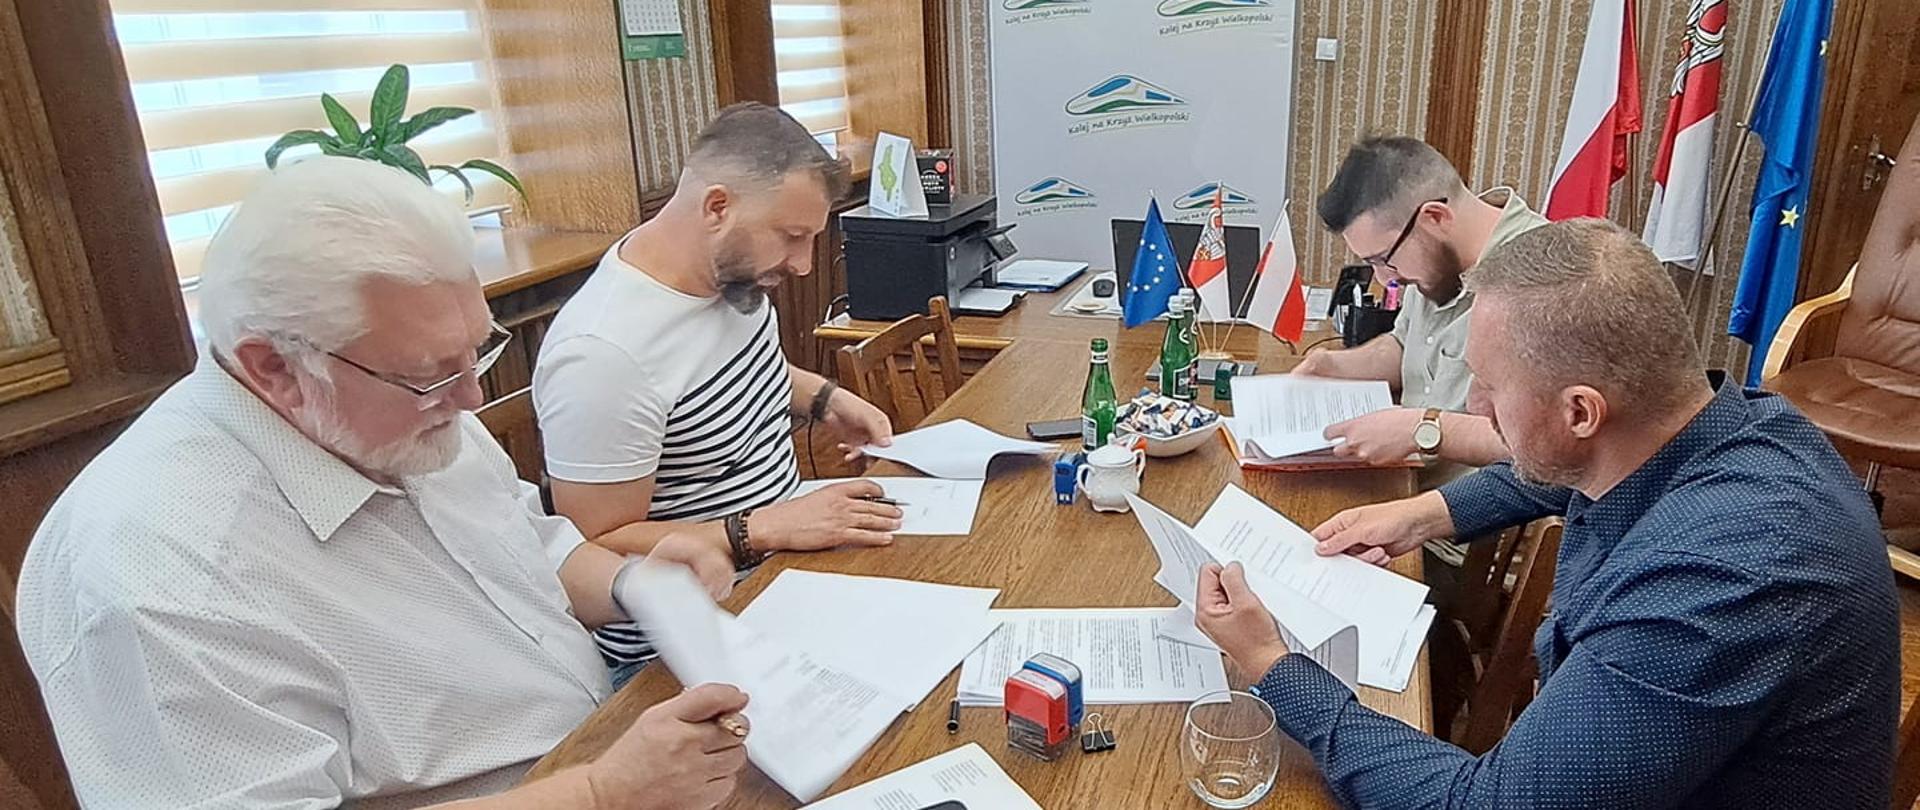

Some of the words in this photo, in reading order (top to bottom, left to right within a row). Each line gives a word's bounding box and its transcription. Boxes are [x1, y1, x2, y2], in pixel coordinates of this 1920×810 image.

[1159, 25, 1179, 35] Kolej
[1182, 21, 1193, 29] na
[1221, 13, 1273, 25] Wielkopolski
[1068, 122, 1090, 133] Kolej
[1135, 112, 1190, 123] Wielkopolski
